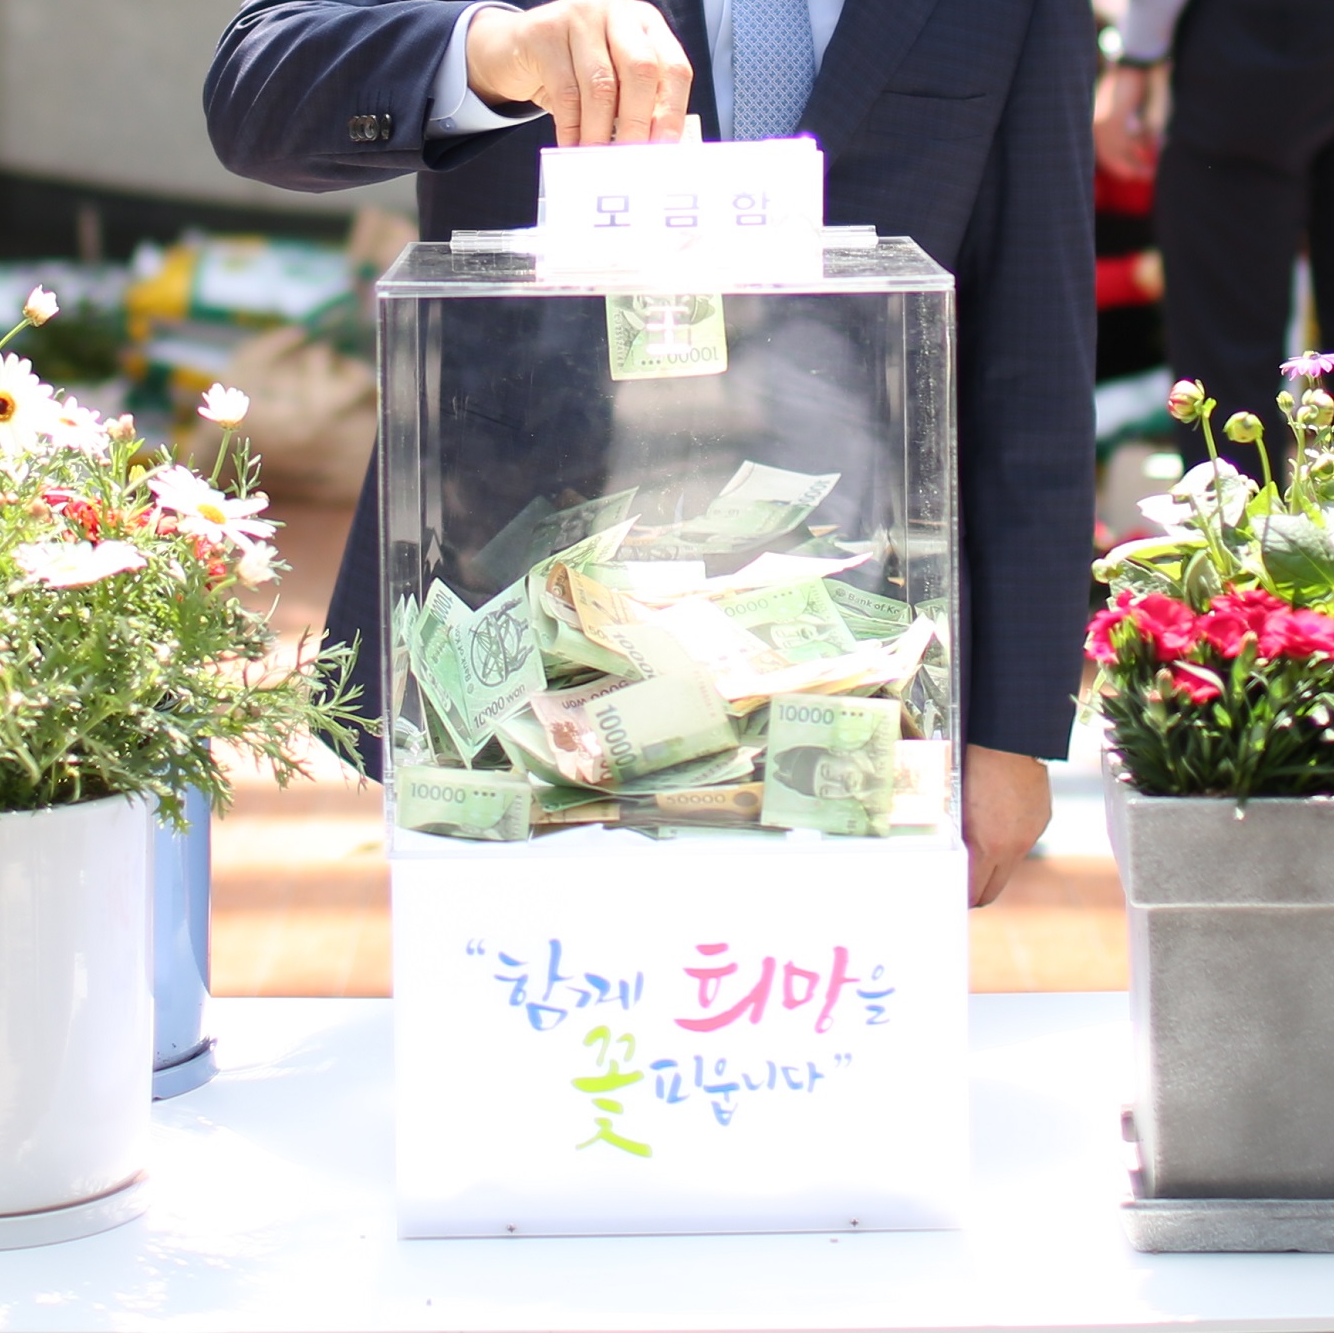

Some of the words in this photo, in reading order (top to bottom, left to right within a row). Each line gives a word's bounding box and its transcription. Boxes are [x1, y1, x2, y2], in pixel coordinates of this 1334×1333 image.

[724, 598, 768, 618] 0000
[848, 593, 872, 607] Bank
[874, 603, 886, 612] of
[613, 632, 657, 679] 1000
[506, 683, 526, 703] won
[778, 704, 835, 725] 10000
[595, 703, 637, 767] 10000
[410, 782, 466, 804] 10000
[674, 942, 897, 1034] 희망을
